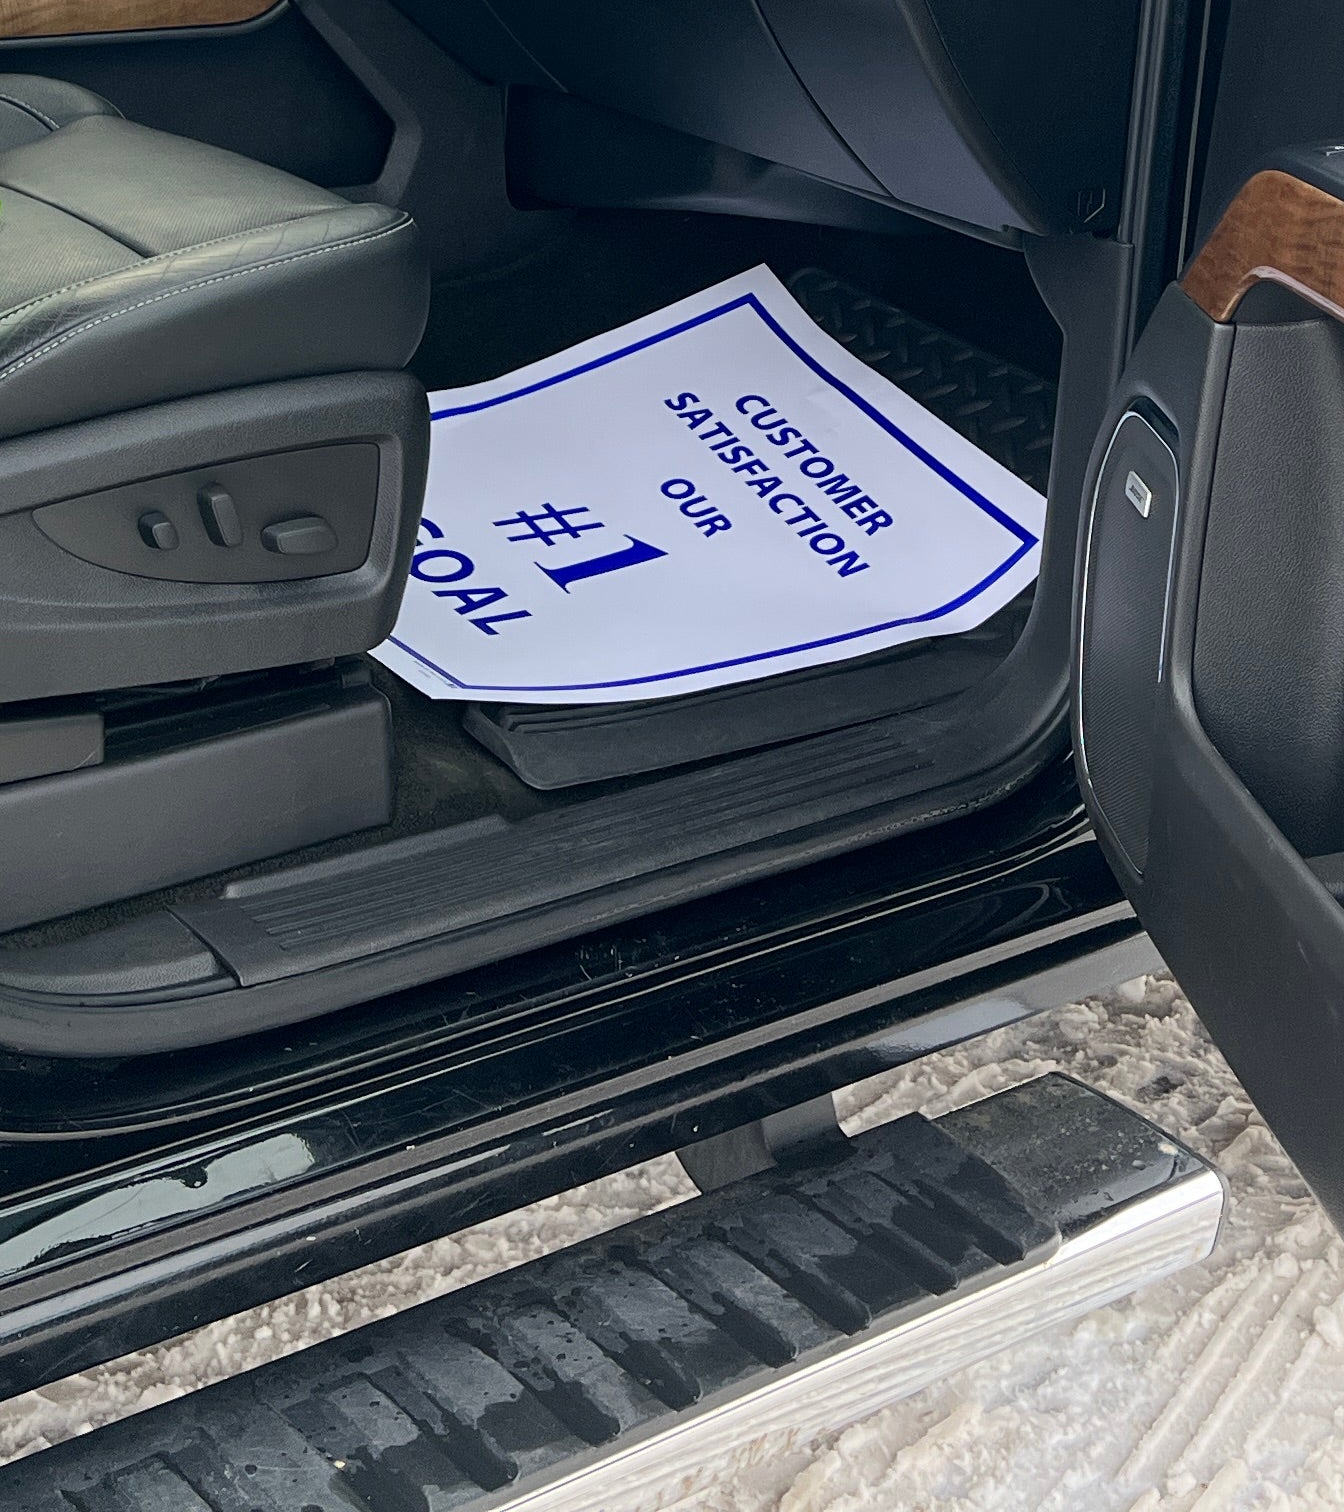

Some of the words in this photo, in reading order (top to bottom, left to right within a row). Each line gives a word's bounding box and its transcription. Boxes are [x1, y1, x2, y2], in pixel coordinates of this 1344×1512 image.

[660, 478, 732, 538] OUR
[664, 391, 870, 579] SATISFACTION
[735, 393, 894, 538] CUSTOMER
[492, 502, 669, 594] #1
